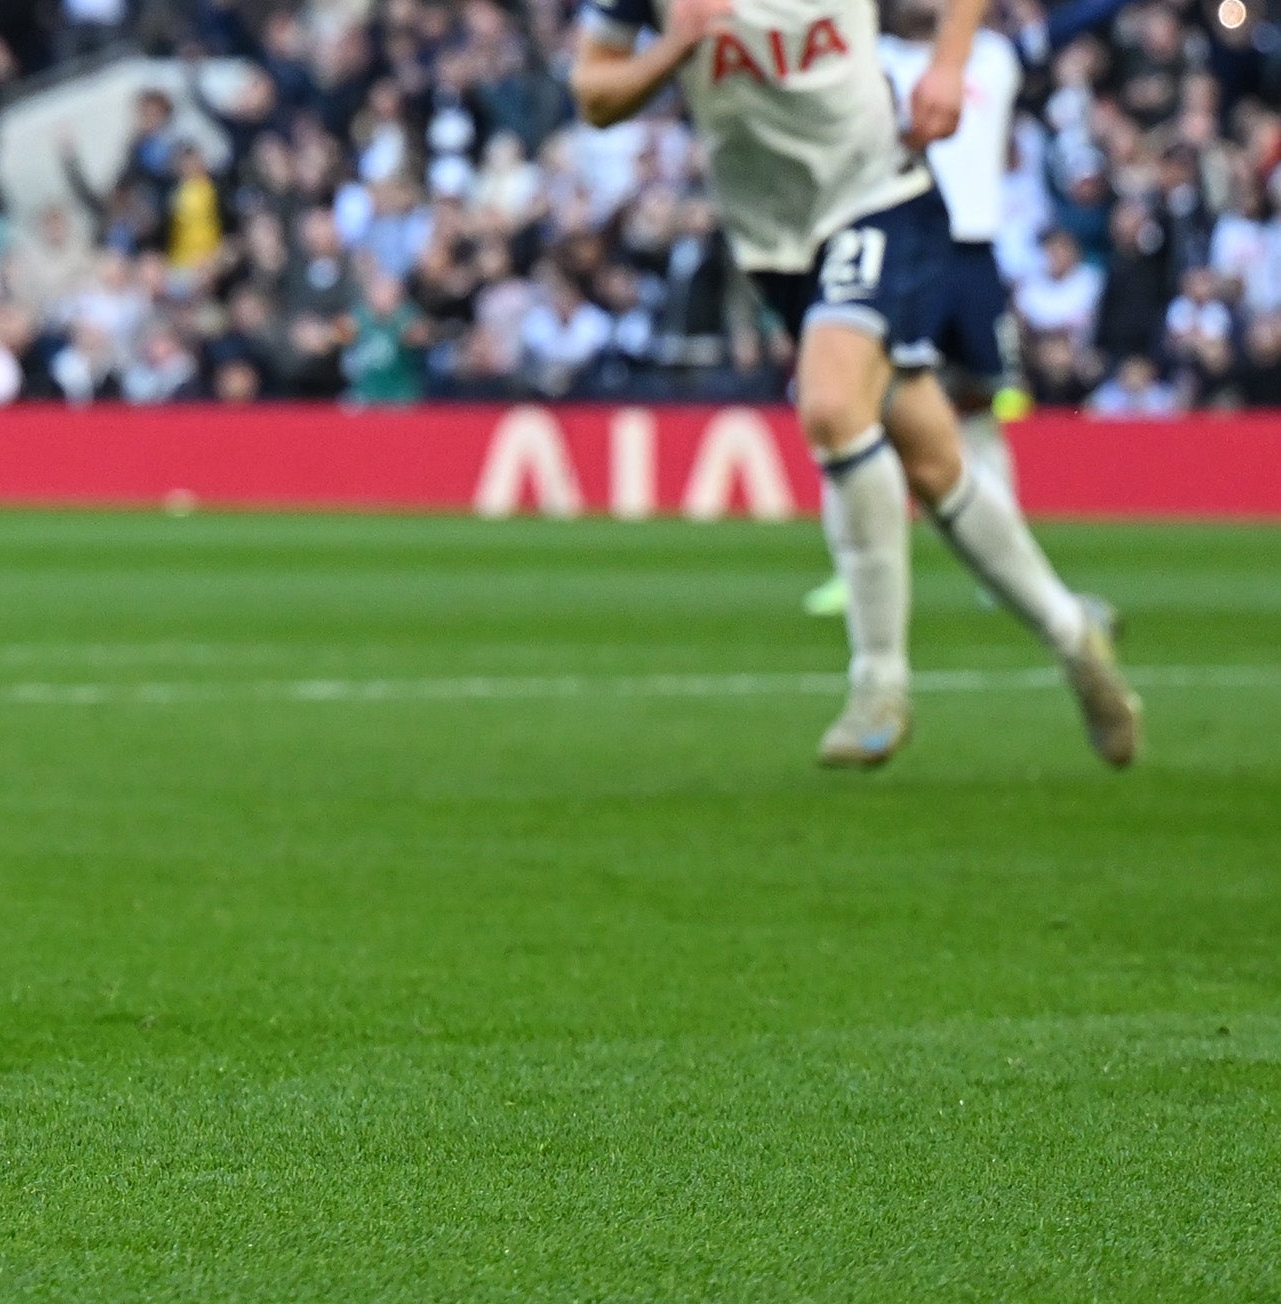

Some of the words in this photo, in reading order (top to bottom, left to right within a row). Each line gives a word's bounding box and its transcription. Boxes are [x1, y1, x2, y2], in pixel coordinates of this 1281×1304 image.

[713, 17, 850, 85] AIA
[820, 226, 887, 289] 21
[473, 405, 797, 520] AIA
